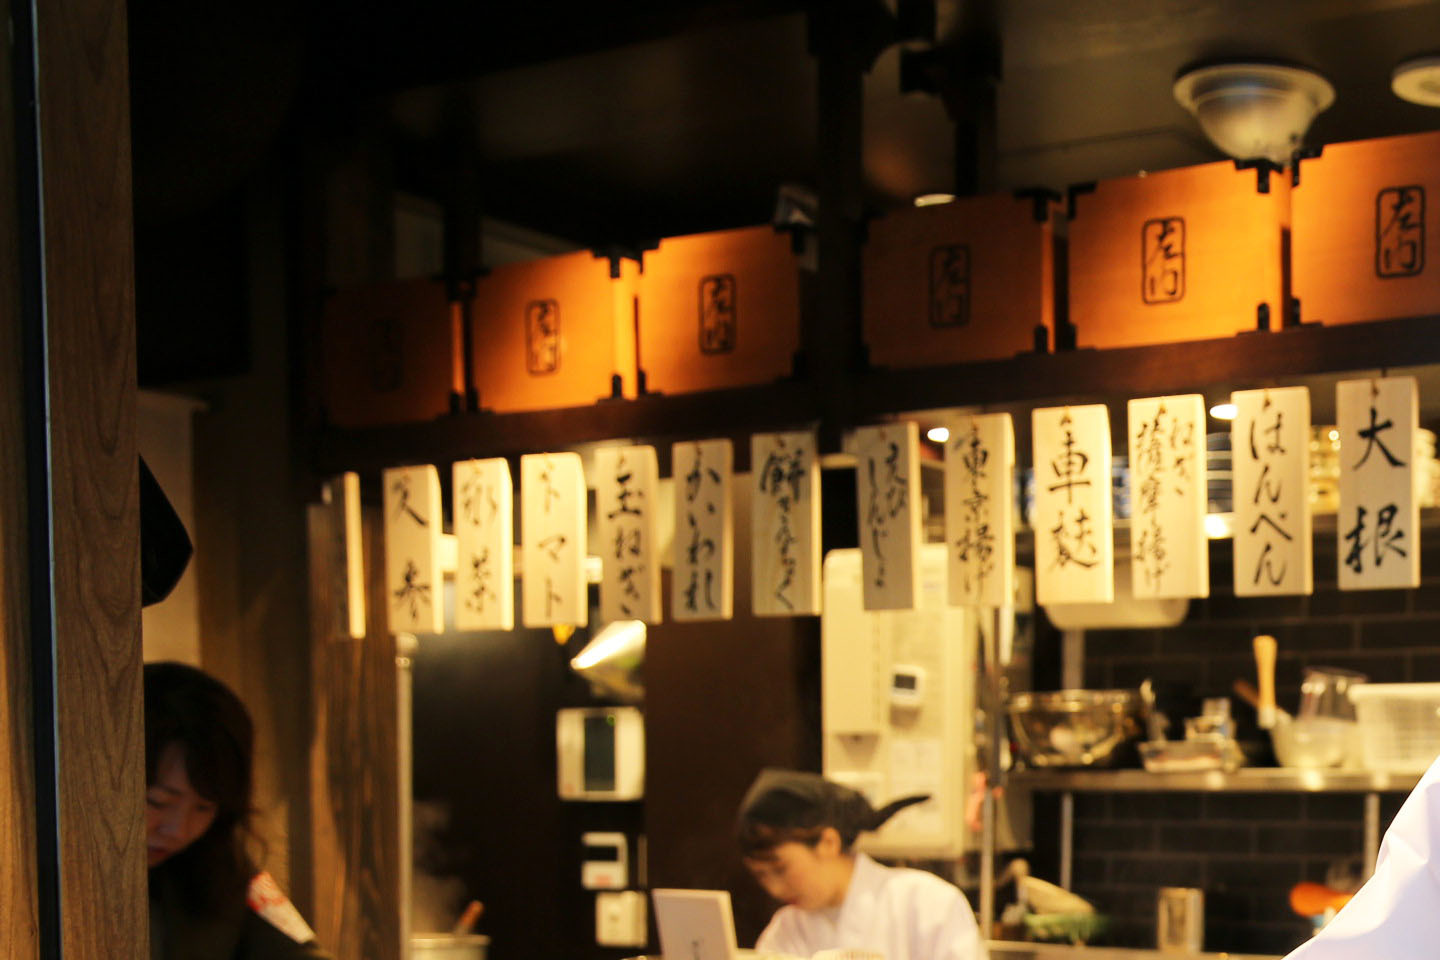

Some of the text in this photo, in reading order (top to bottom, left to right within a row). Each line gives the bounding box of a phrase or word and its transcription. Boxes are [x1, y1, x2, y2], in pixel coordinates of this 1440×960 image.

[1250, 413, 1293, 586] はんぺん
[1344, 406, 1407, 575] 大根
